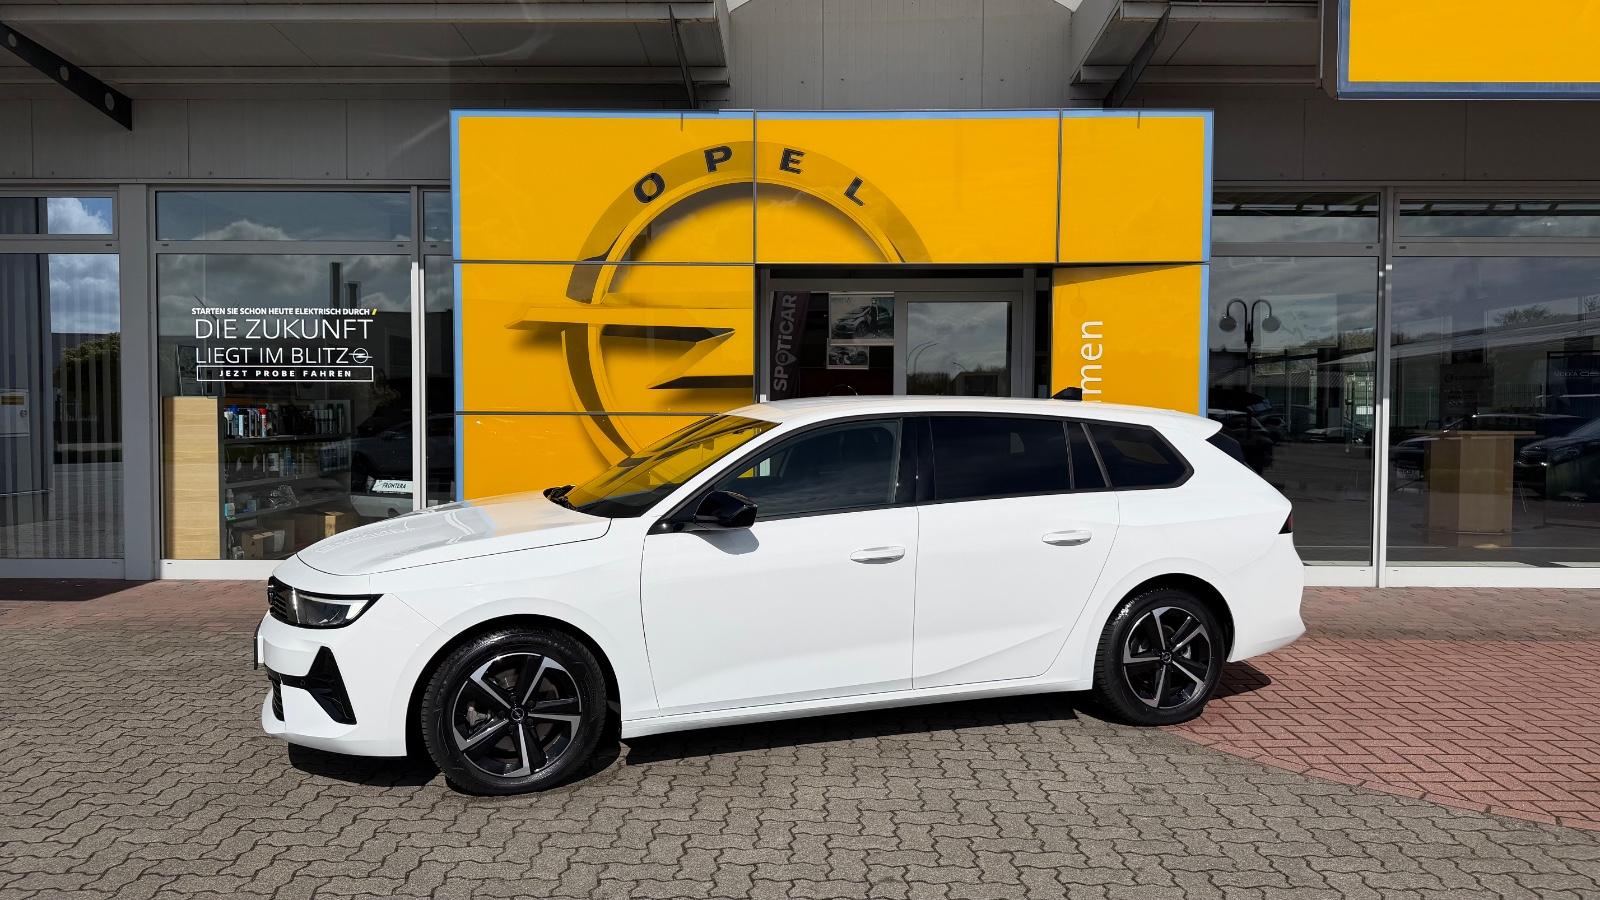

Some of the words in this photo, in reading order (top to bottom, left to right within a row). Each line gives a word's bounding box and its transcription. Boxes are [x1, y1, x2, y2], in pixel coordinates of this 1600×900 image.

[633, 145, 865, 207] OPEL
[191, 307, 226, 315] STARTEN
[226, 307, 239, 315] SIE
[240, 307, 267, 315] SCHON
[268, 307, 294, 315] HEUTE
[294, 308, 342, 316] ELEKTRISCH
[342, 308, 370, 316] DURCH
[195, 318, 237, 340] DIE
[245, 318, 374, 340] ZUKUNFT
[195, 347, 253, 364] LIEGT
[260, 347, 283, 364] IM
[291, 347, 349, 364] BLITZ
[1080, 321, 1104, 404] men
